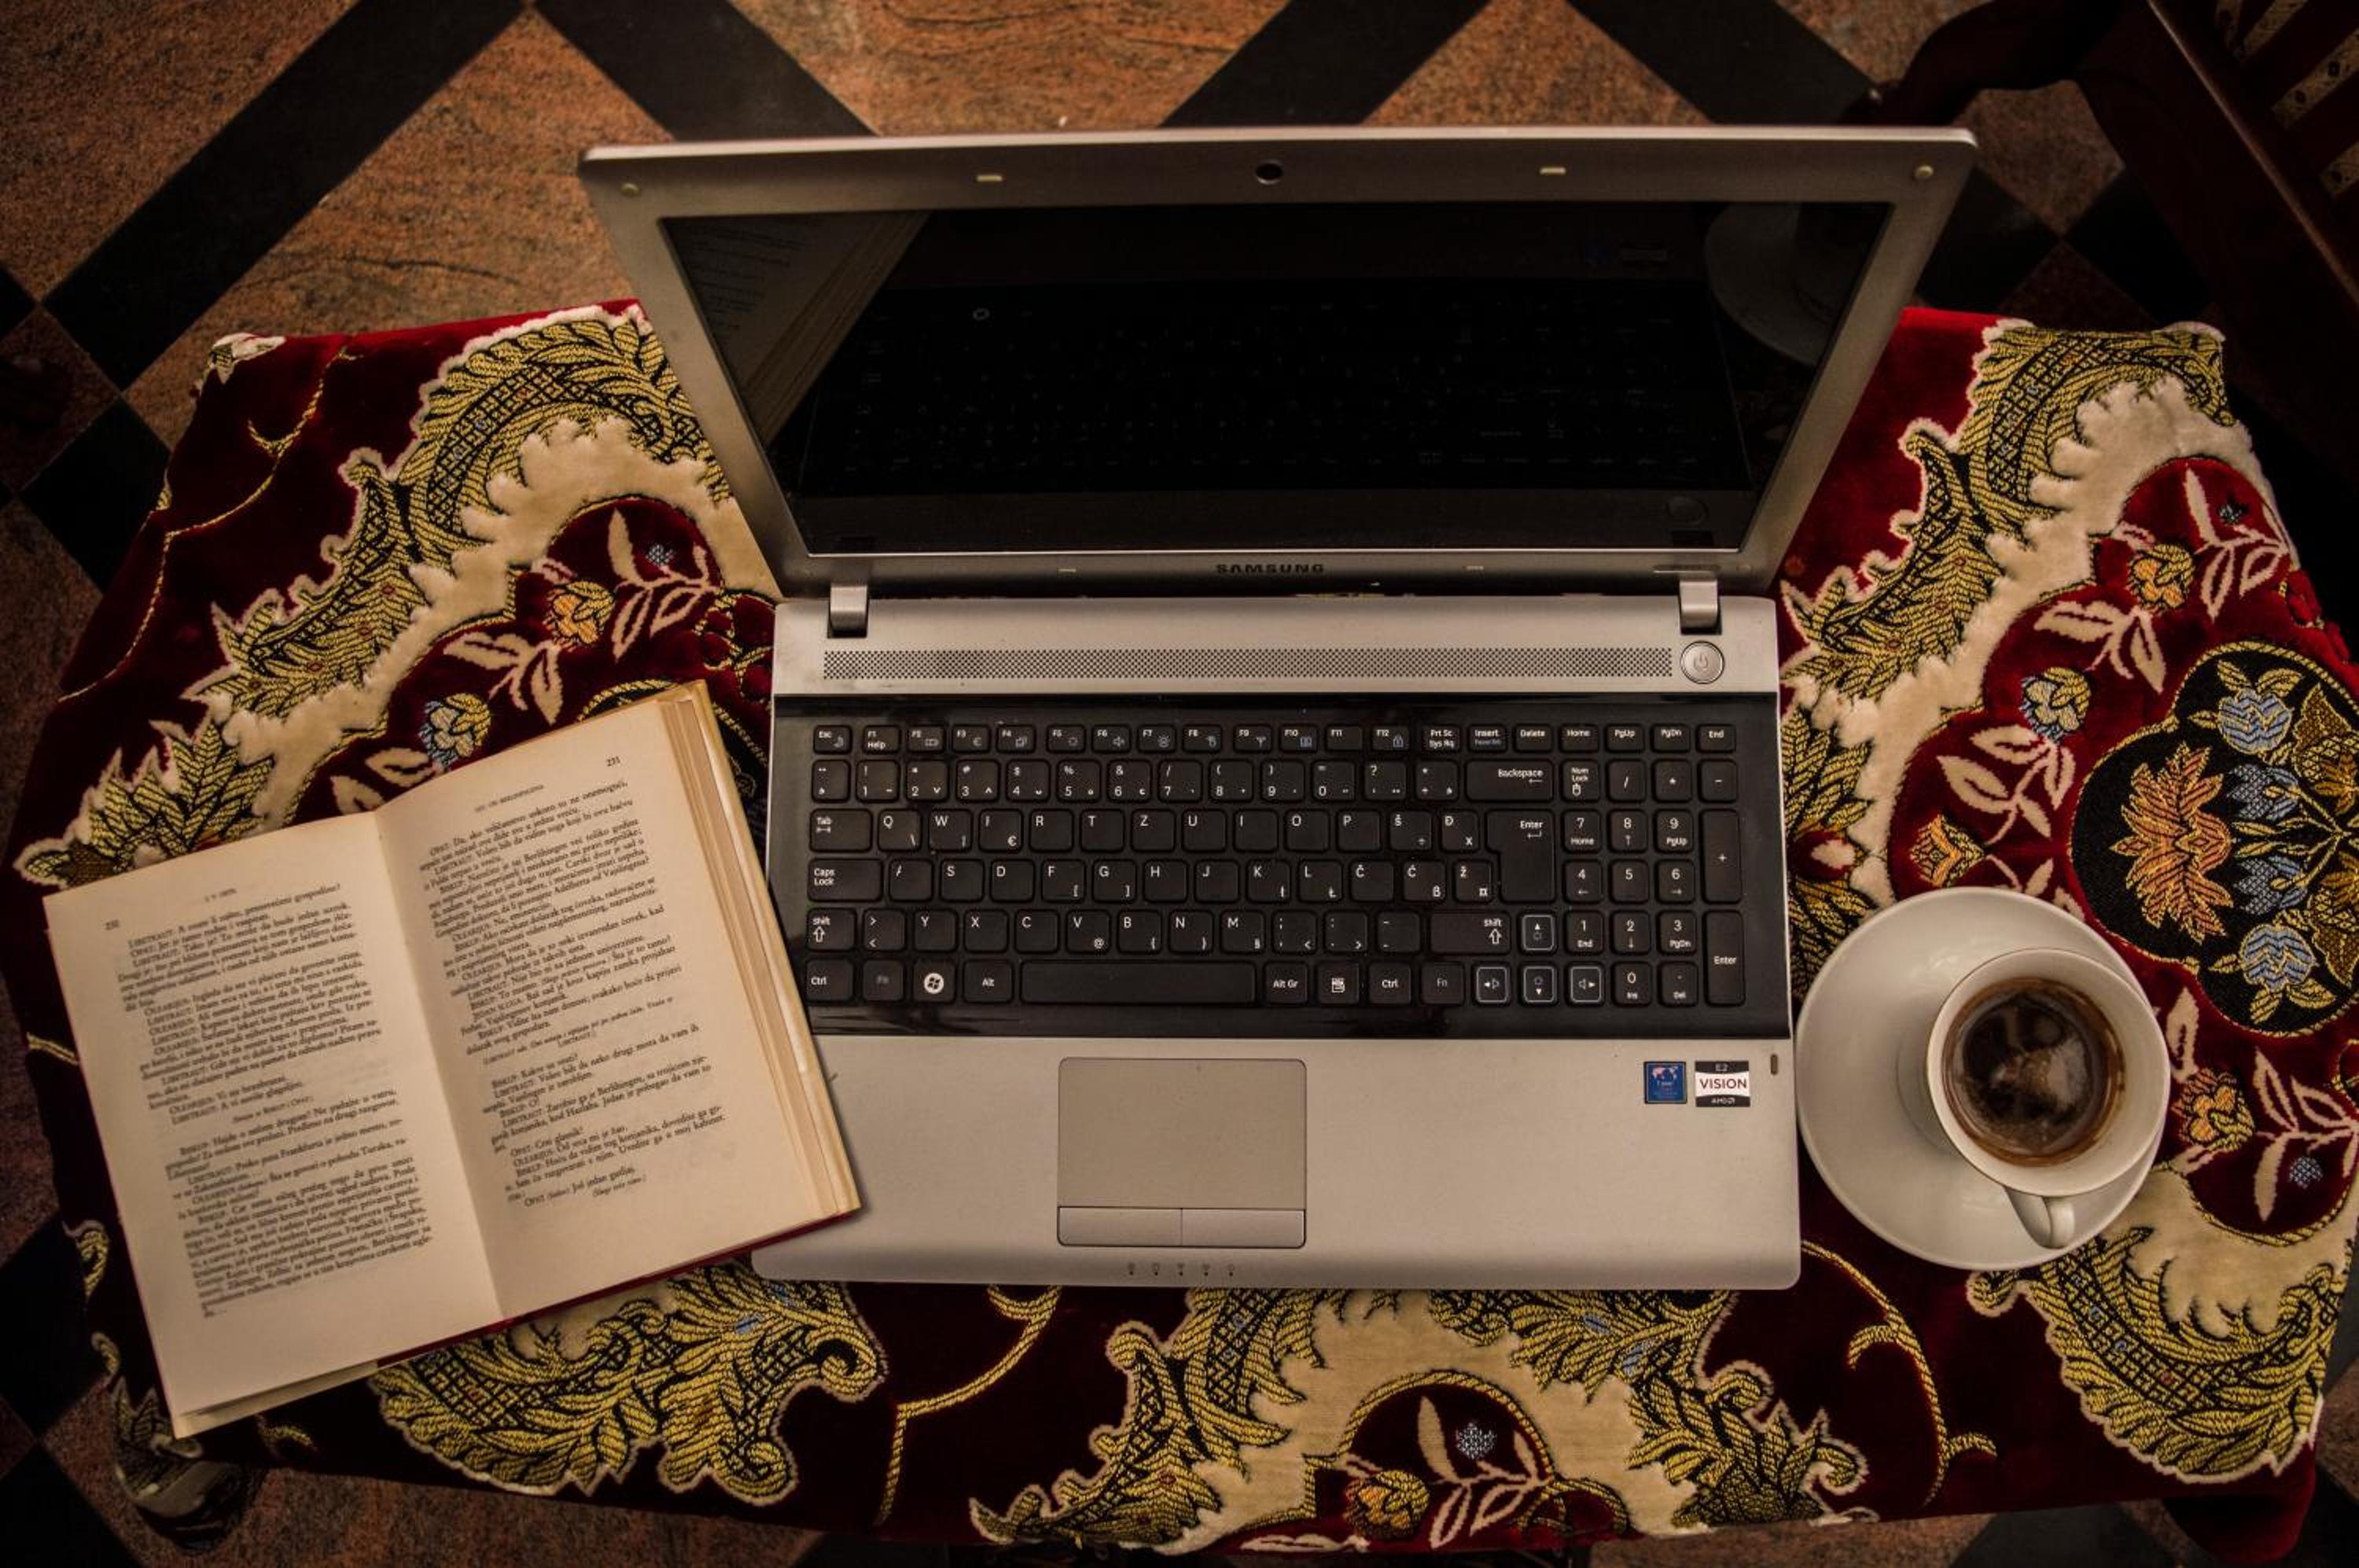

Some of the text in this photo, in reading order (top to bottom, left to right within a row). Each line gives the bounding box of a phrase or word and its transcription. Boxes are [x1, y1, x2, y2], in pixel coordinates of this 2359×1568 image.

[1216, 564, 1324, 573] SAMSUNG
[1662, 729, 1681, 738] PgDn
[868, 741, 885, 749] Help
[1371, 765, 1377, 775] ?
[912, 786, 918, 796] 2
[962, 786, 969, 796] 3
[1013, 786, 1019, 795] 4
[1065, 786, 1072, 796] 5
[1115, 786, 1122, 796] 6
[1165, 786, 1171, 796] 7
[1216, 786, 1223, 796] 8
[1268, 786, 1275, 796] 9
[884, 815, 893, 829] Q
[935, 816, 948, 826] W
[1036, 815, 1043, 826] R
[1088, 815, 1095, 826] T
[1140, 815, 1148, 826] Z
[1189, 815, 1197, 826] U
[1344, 815, 1351, 826] P
[1577, 818, 1584, 828] 7
[1624, 818, 1631, 829] 8
[1670, 818, 1678, 829] 9
[1008, 836, 1016, 846] €
[1667, 837, 1687, 846] PgUp
[815, 868, 834, 879] Caps
[948, 866, 955, 876] S
[997, 866, 1005, 877] D
[1048, 866, 1054, 876] F
[1099, 866, 1109, 877] G
[1151, 867, 1159, 877] H
[1202, 867, 1209, 877] J
[1254, 867, 1261, 877] K
[1305, 867, 1311, 878] L
[1579, 869, 1585, 879] 4
[1626, 869, 1632, 879] 5
[1672, 869, 1680, 879] 6
[815, 875, 834, 885] Lock
[922, 916, 929, 926] Y
[972, 917, 979, 927] X
[1022, 917, 1031, 928] C
[1073, 917, 1082, 927] V
[1124, 917, 1131, 928] B
[1176, 917, 1184, 928] N
[1228, 918, 1238, 927] M
[1627, 920, 1634, 931] 2
[1674, 920, 1682, 931] 3
[1699, 1078, 1747, 1089] VISION
